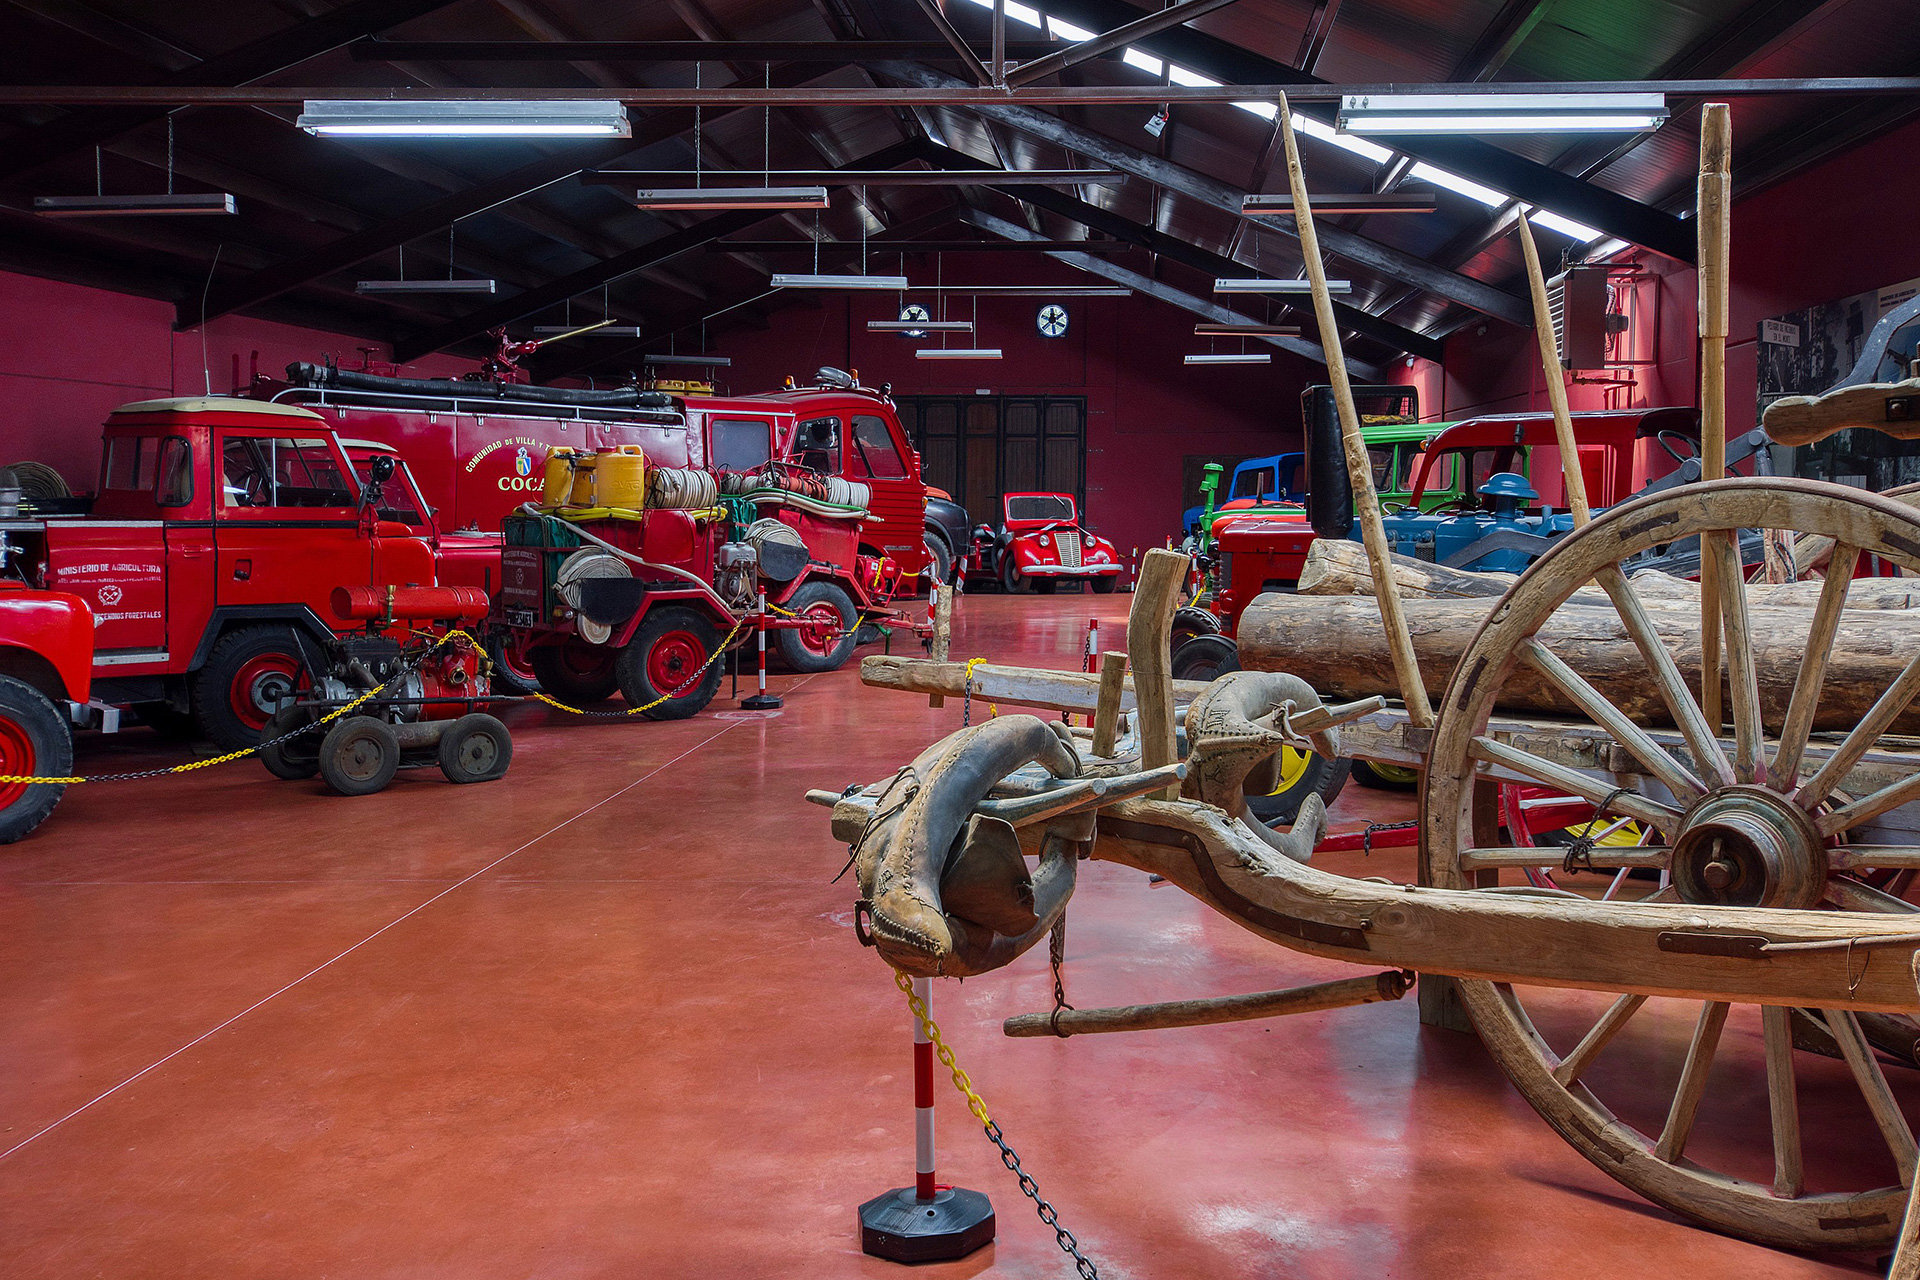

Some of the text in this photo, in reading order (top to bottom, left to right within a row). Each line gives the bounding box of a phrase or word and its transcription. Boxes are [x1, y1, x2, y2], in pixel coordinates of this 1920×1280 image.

[465, 440, 502, 473] COMUNIDAD
[504, 437, 513, 446] DE
[515, 436, 536, 446] VILLA
[57, 563, 161, 575] MINISTERIO DE AGRICULTURA
[125, 611, 161, 620] FORESTALES
